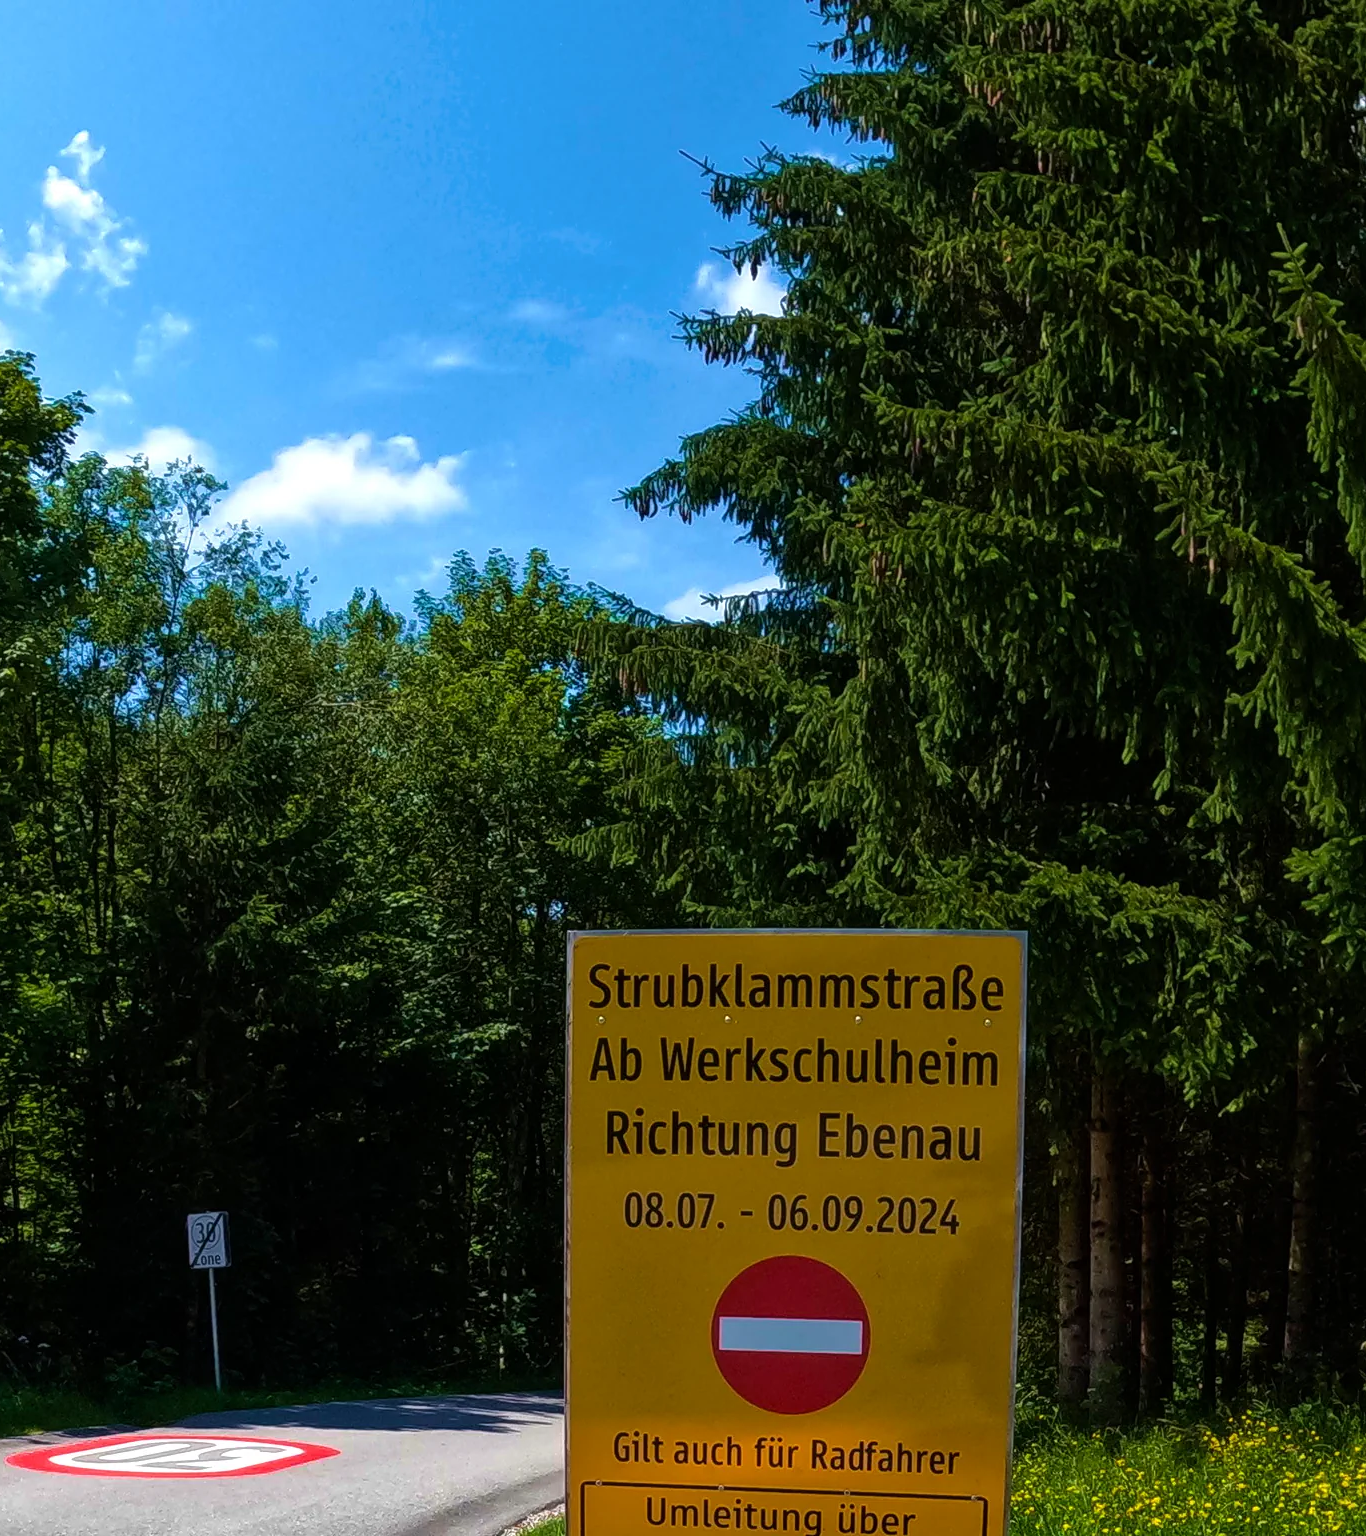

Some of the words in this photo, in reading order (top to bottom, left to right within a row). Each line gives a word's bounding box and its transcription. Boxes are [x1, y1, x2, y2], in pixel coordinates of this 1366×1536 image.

[588, 963, 1004, 1011] Strubklammstraße
[589, 1037, 642, 1082] Ab
[660, 1037, 998, 1086] Werkschulheim
[606, 1107, 797, 1168] Richtung
[818, 1112, 981, 1162] Ebenau
[195, 1221, 216, 1244] 30
[624, 1191, 725, 1229] 08.07.
[768, 1194, 960, 1235] 06.09.2024
[193, 1252, 222, 1266] Zone
[613, 1430, 664, 1464] Gilt
[673, 1436, 742, 1466] auch
[754, 1436, 799, 1469] für
[811, 1439, 960, 1475] Radfahrer
[838, 1503, 916, 1536] über
